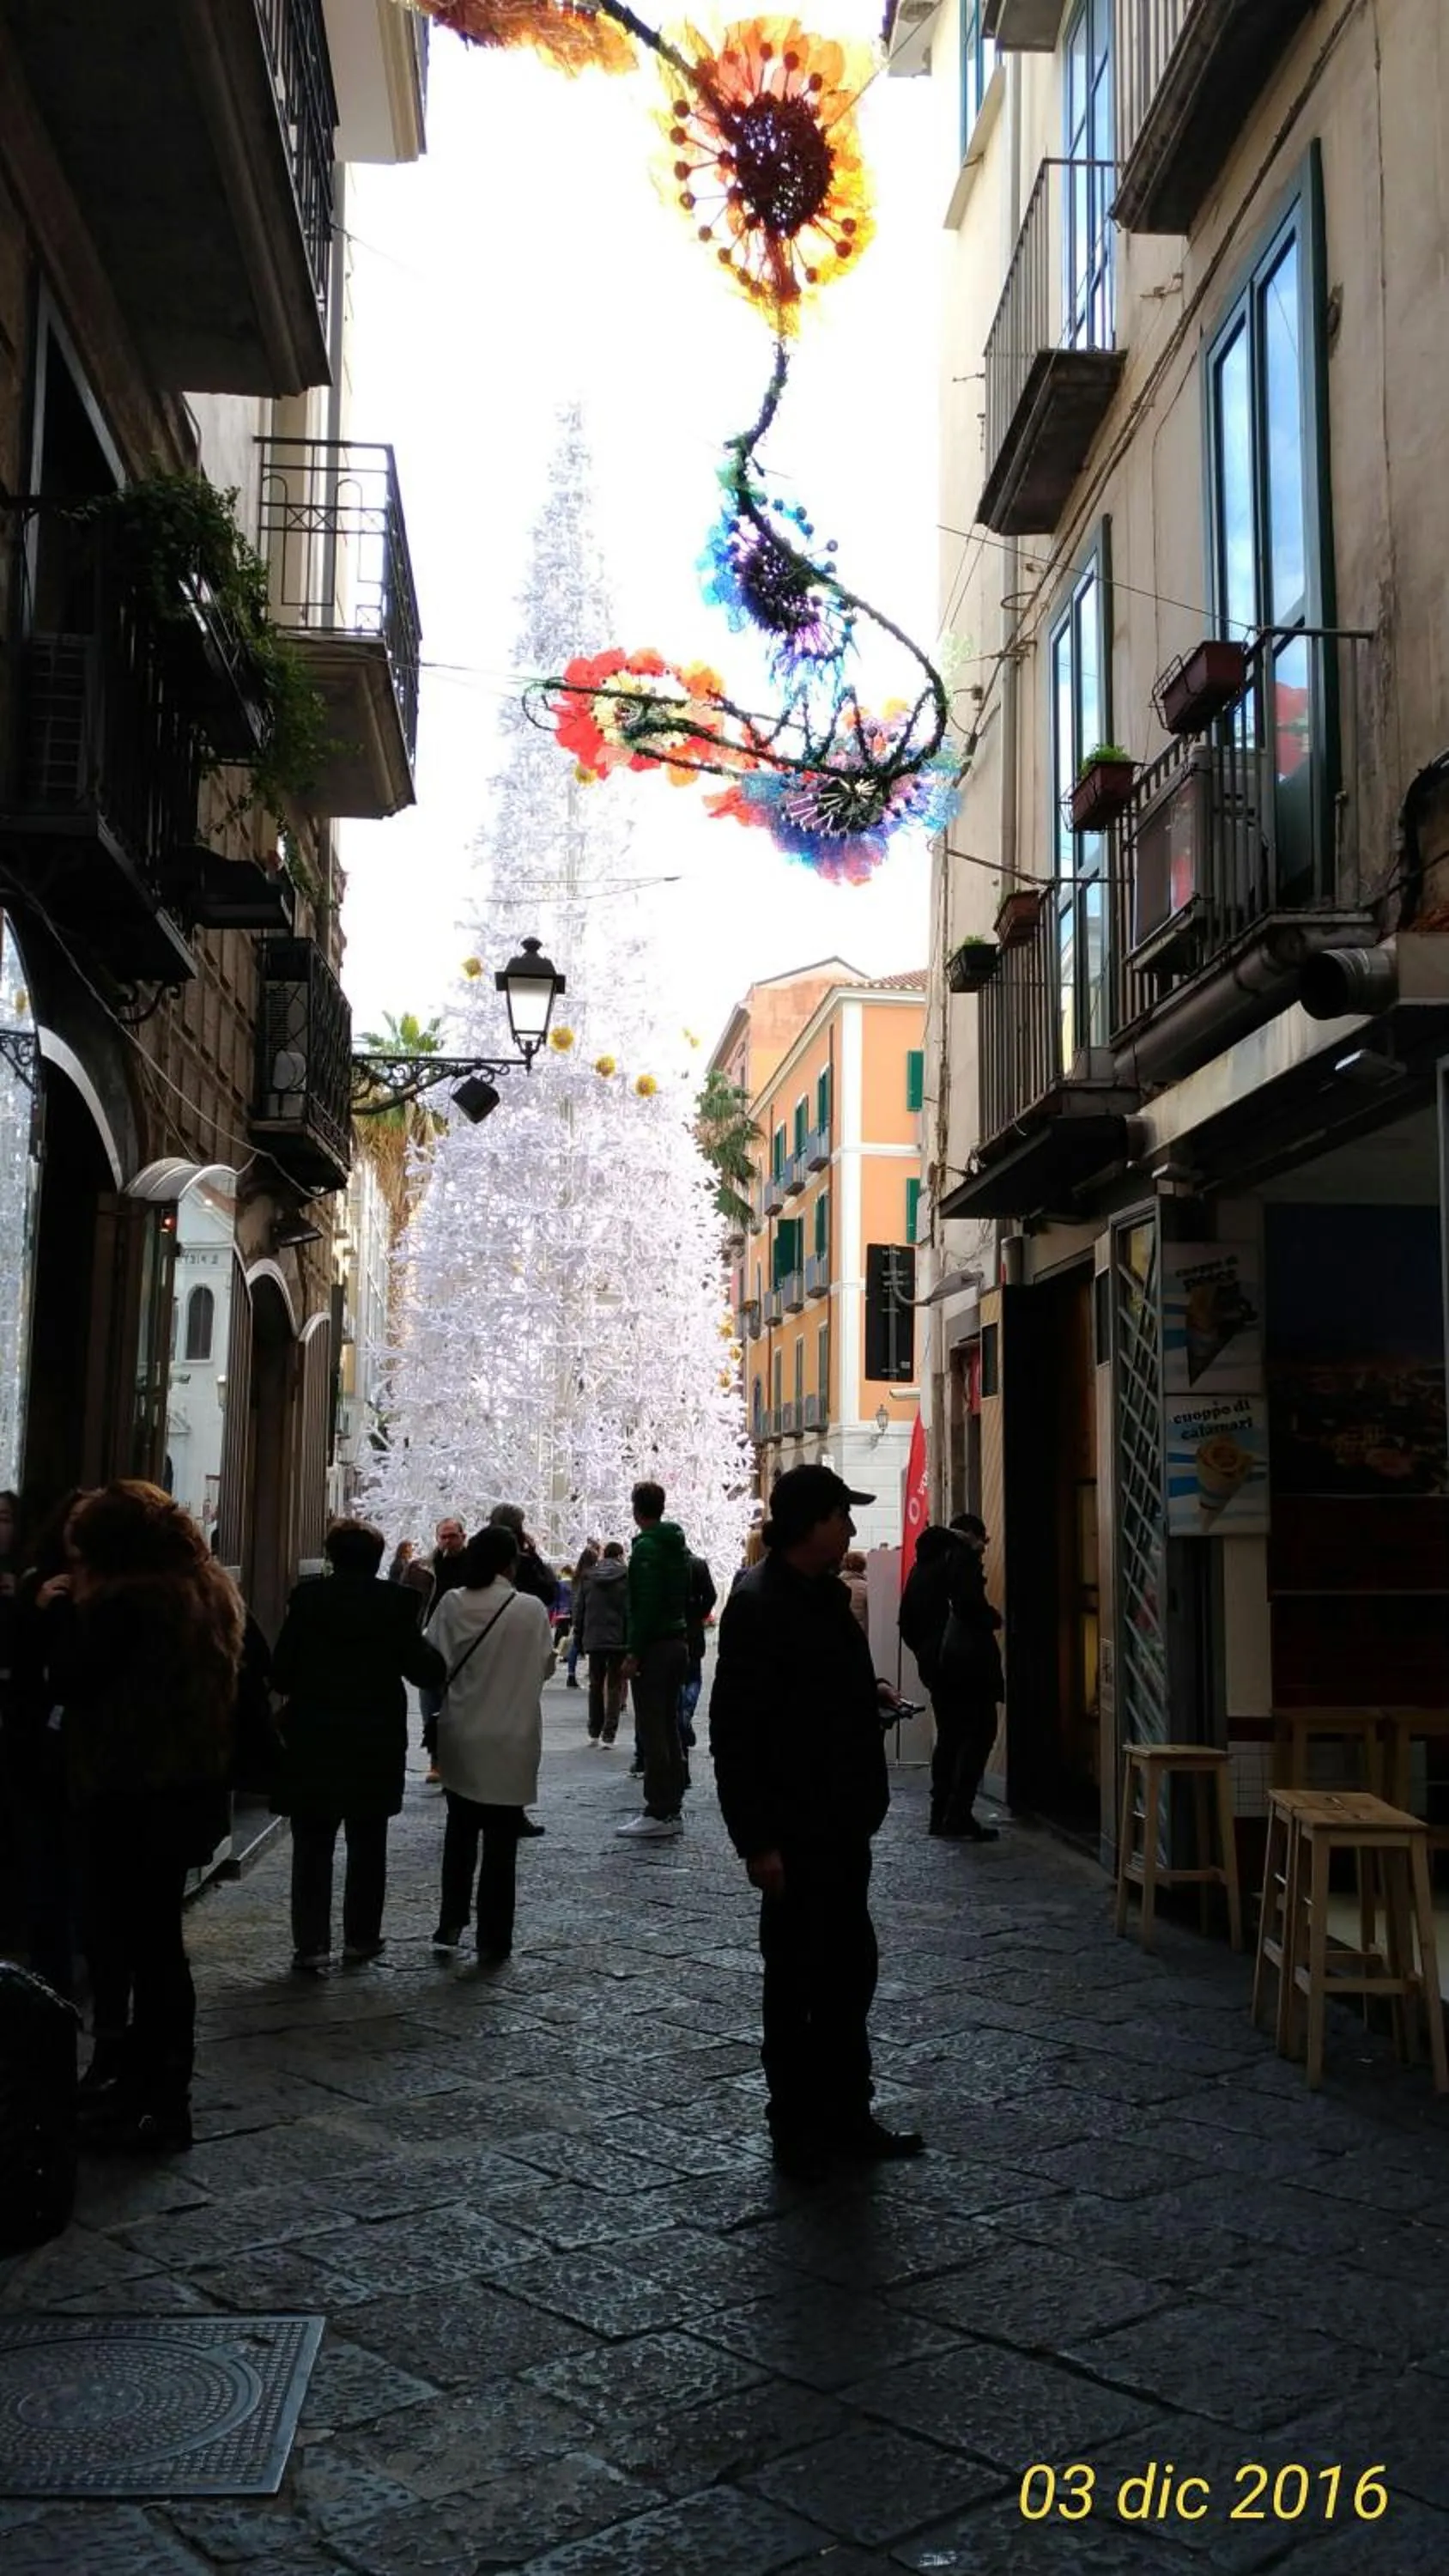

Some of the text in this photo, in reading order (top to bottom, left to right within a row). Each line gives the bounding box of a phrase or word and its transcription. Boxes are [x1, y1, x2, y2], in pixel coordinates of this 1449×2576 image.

[1173, 1399, 1251, 1425] cuoppo di
[1181, 1417, 1252, 1440] calamari
